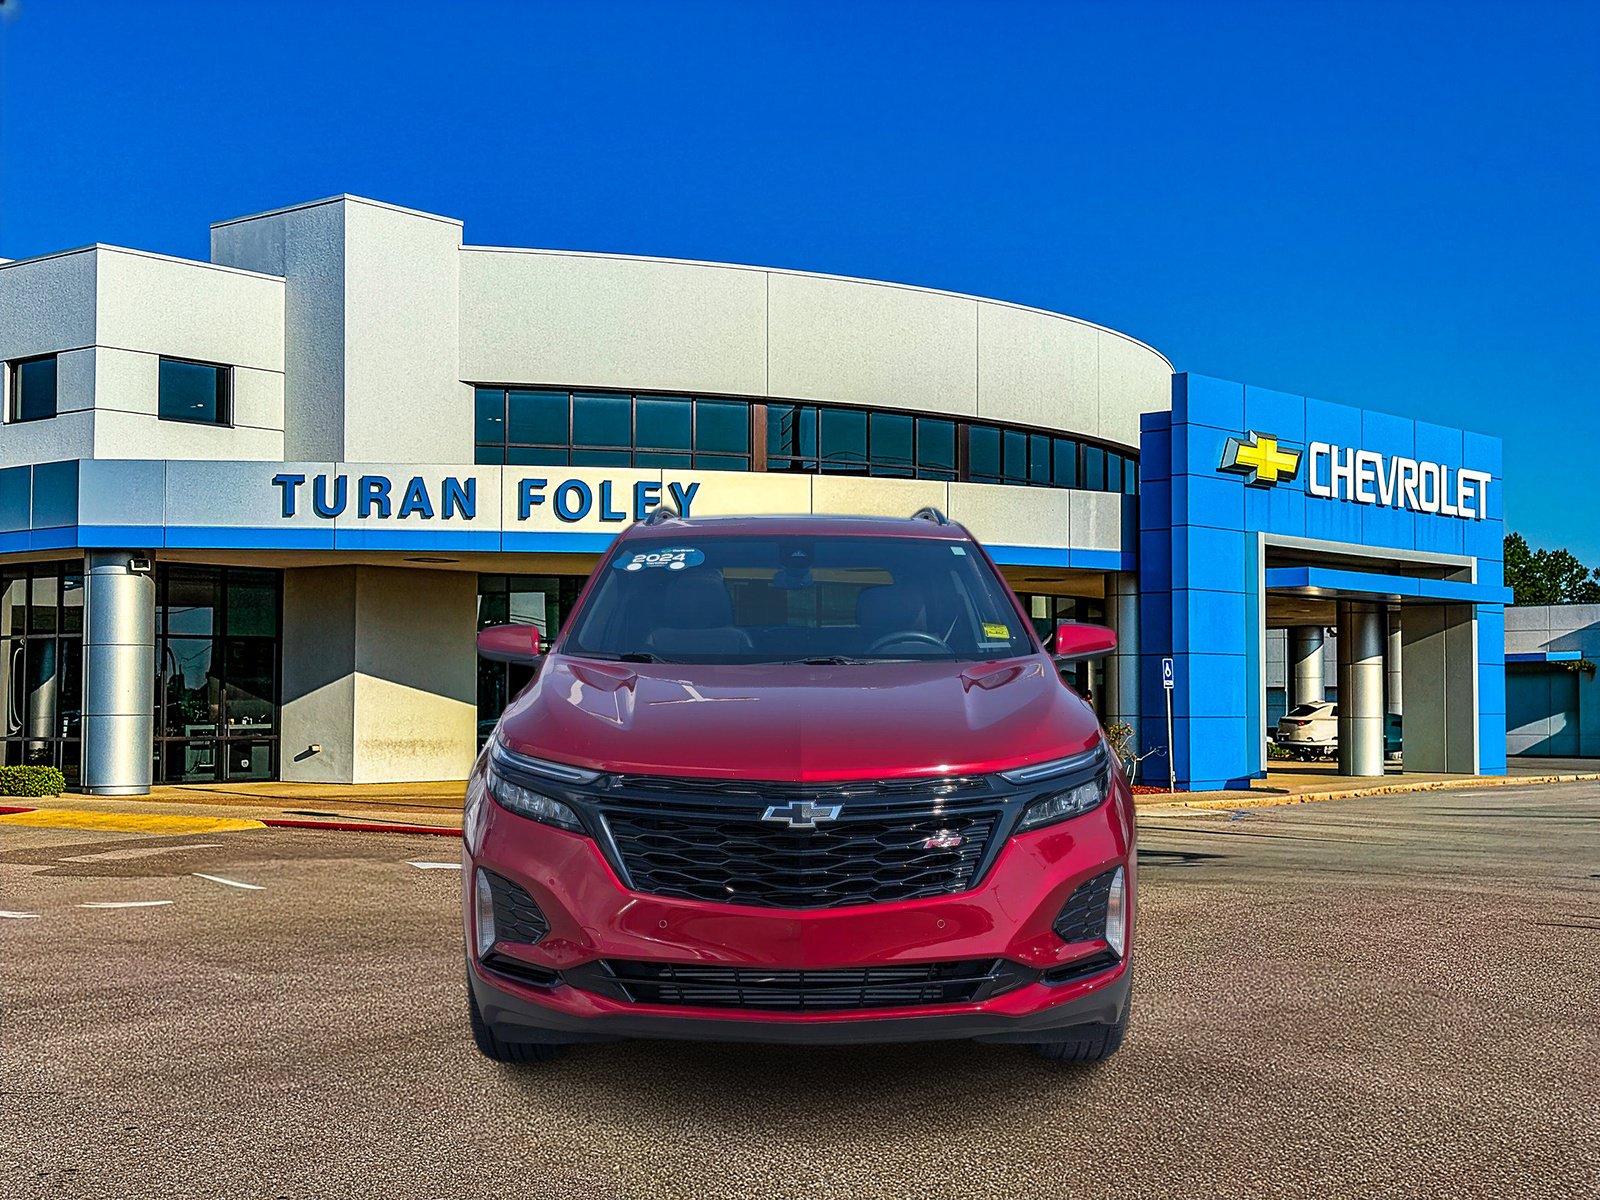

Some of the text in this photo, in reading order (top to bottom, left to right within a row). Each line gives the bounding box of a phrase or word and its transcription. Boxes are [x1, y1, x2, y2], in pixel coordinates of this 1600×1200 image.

[271, 473, 701, 523] TURAN FOLEY
[1307, 441, 1492, 520] CHEVROLET
[632, 552, 686, 563] 2024
